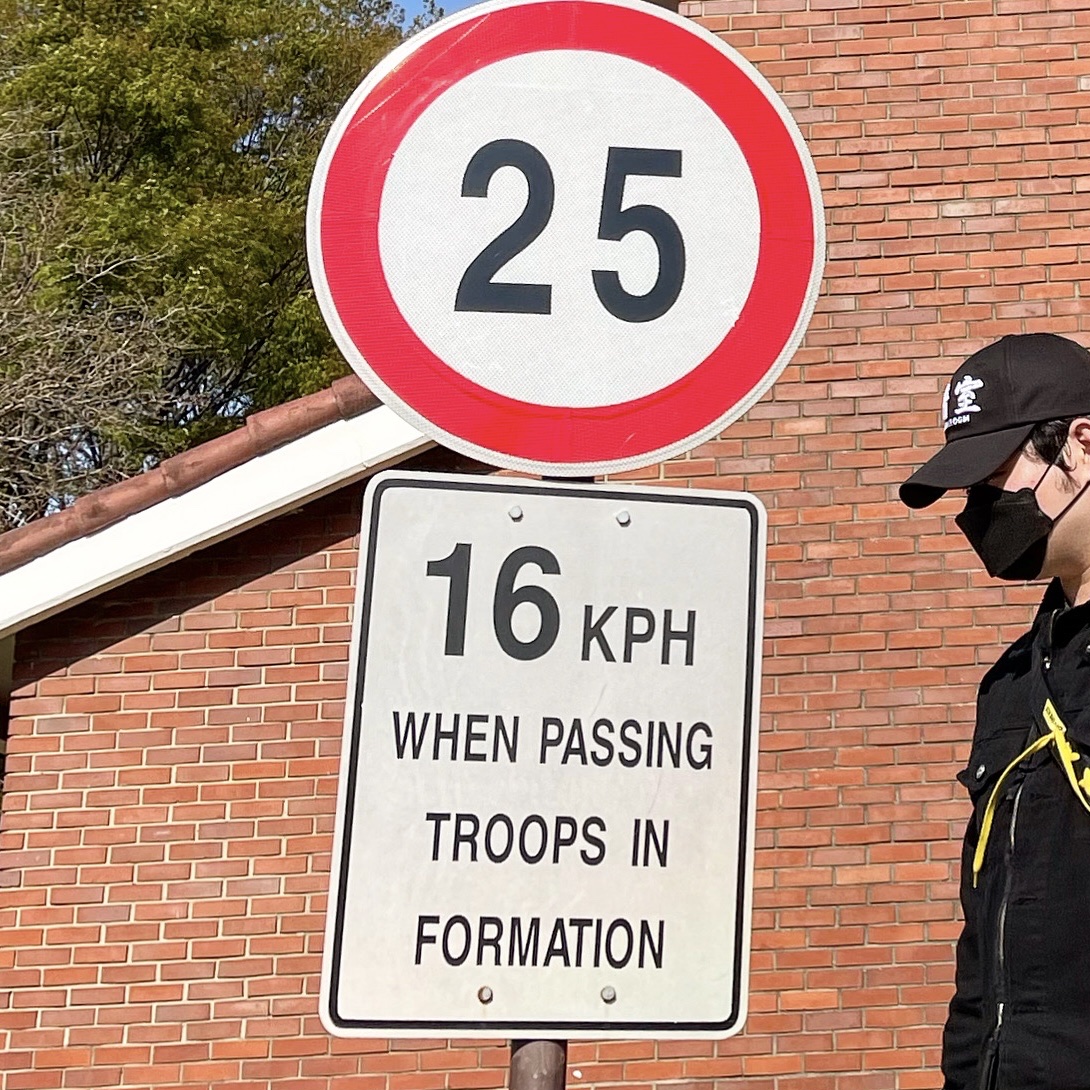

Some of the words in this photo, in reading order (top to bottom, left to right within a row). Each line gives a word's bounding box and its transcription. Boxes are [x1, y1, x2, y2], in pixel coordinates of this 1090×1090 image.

[453, 138, 686, 324] 25
[426, 542, 561, 661] 16
[581, 604, 697, 666] KPH
[392, 711, 520, 763] WHEN
[539, 716, 713, 770] PASSING
[425, 812, 607, 866] TROOPS
[631, 818, 670, 868] IN
[414, 914, 665, 969] FORMATION
